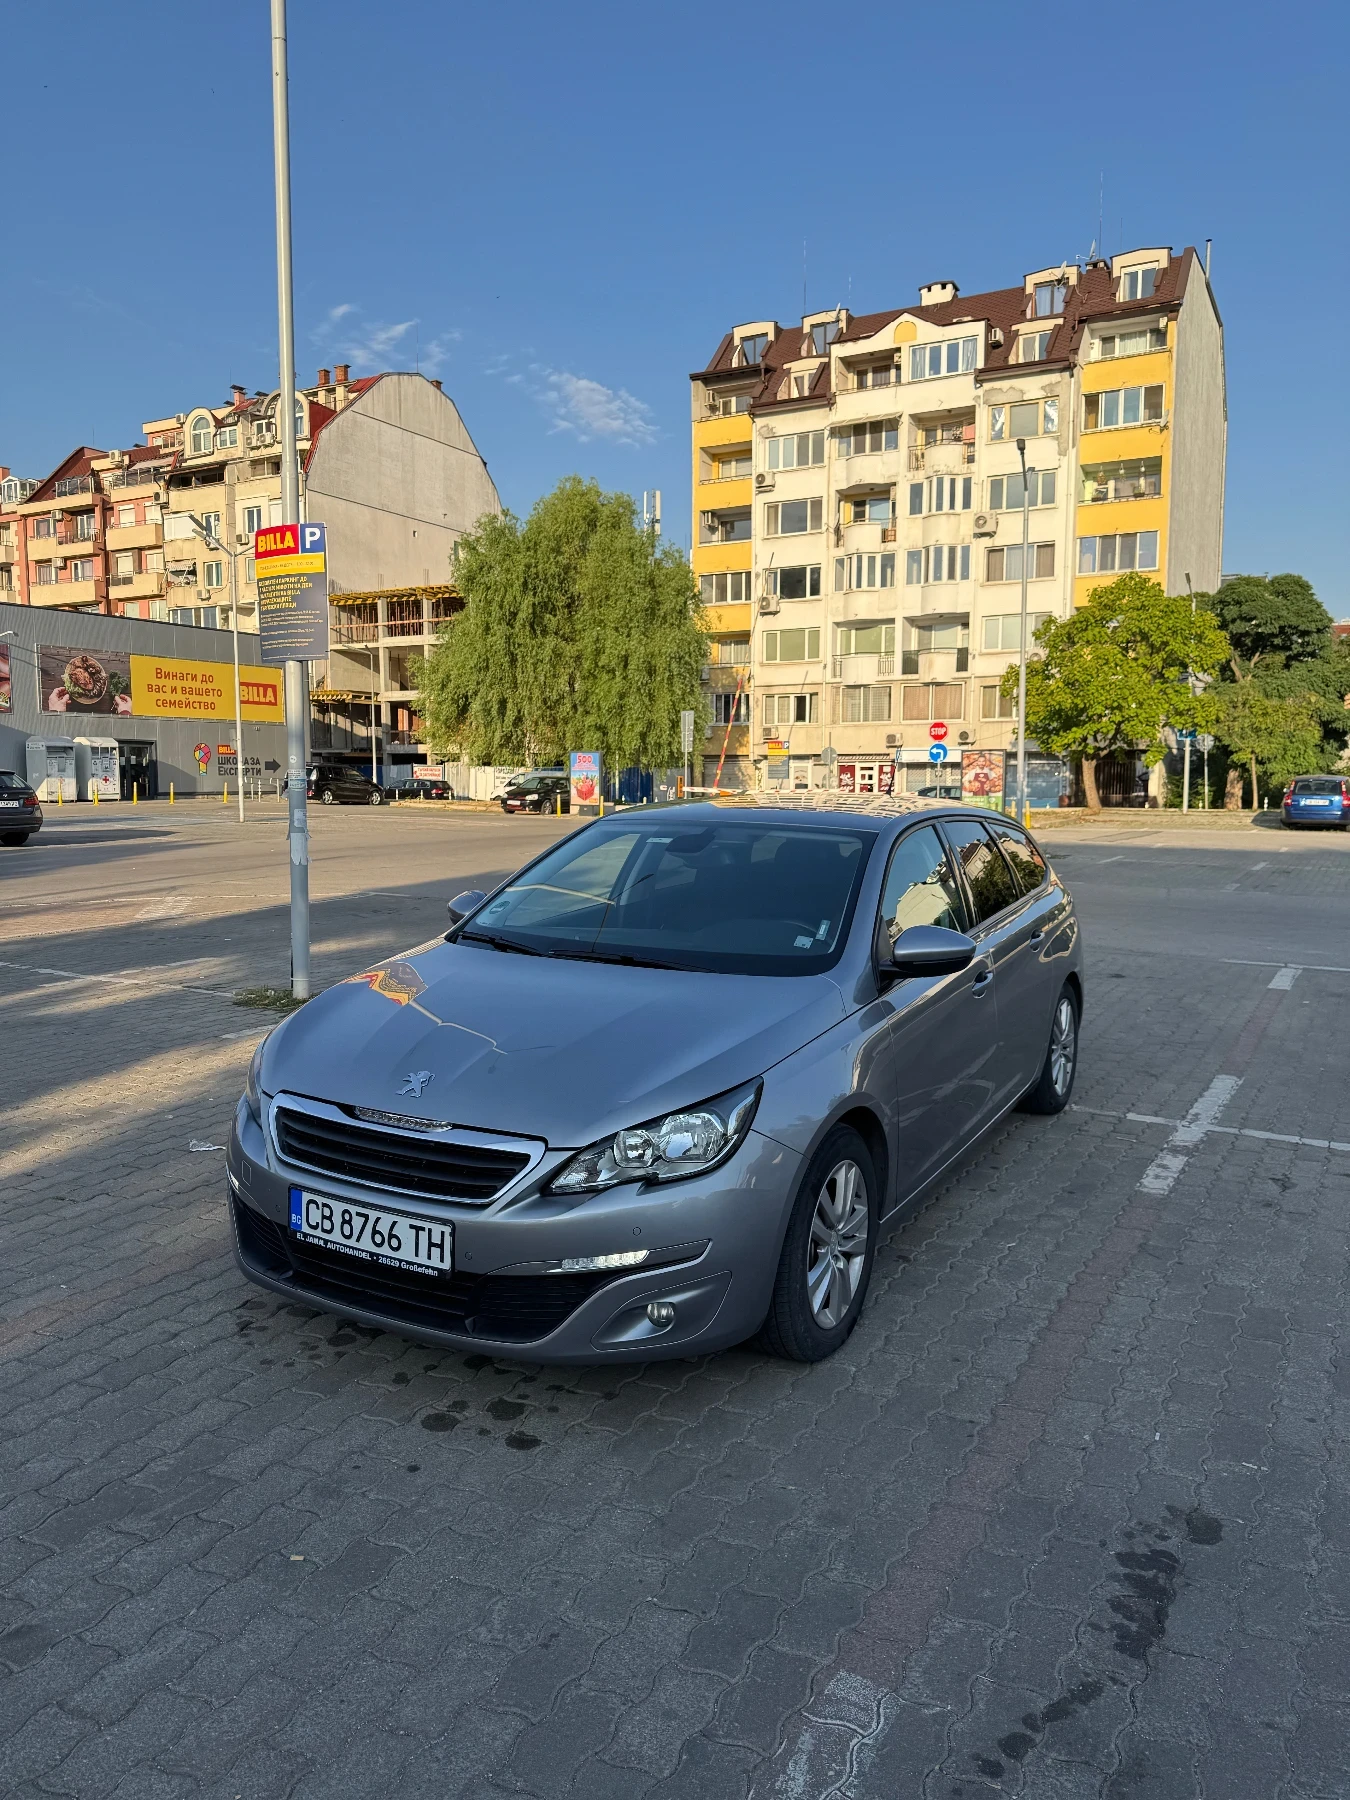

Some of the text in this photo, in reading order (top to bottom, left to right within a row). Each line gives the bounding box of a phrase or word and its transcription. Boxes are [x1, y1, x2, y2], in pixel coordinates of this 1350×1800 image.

[258, 531, 295, 552] BILLA
[305, 527, 321, 549] P
[155, 667, 214, 685] Винаги до
[147, 683, 223, 698] вас и вашето
[240, 685, 275, 703] BILLA
[155, 697, 216, 711] семейство
[930, 728, 947, 736] STOP
[217, 756, 250, 765] ШКОА
[577, 755, 593, 764] 500
[291, 1213, 302, 1225] BG
[305, 1198, 445, 1264] CB 8766 TH
[296, 1232, 305, 1241] EL
[326, 1242, 372, 1260] AUTOHANDEL
[378, 1256, 400, 1268] 26629
[400, 1262, 438, 1277] Großefehn
